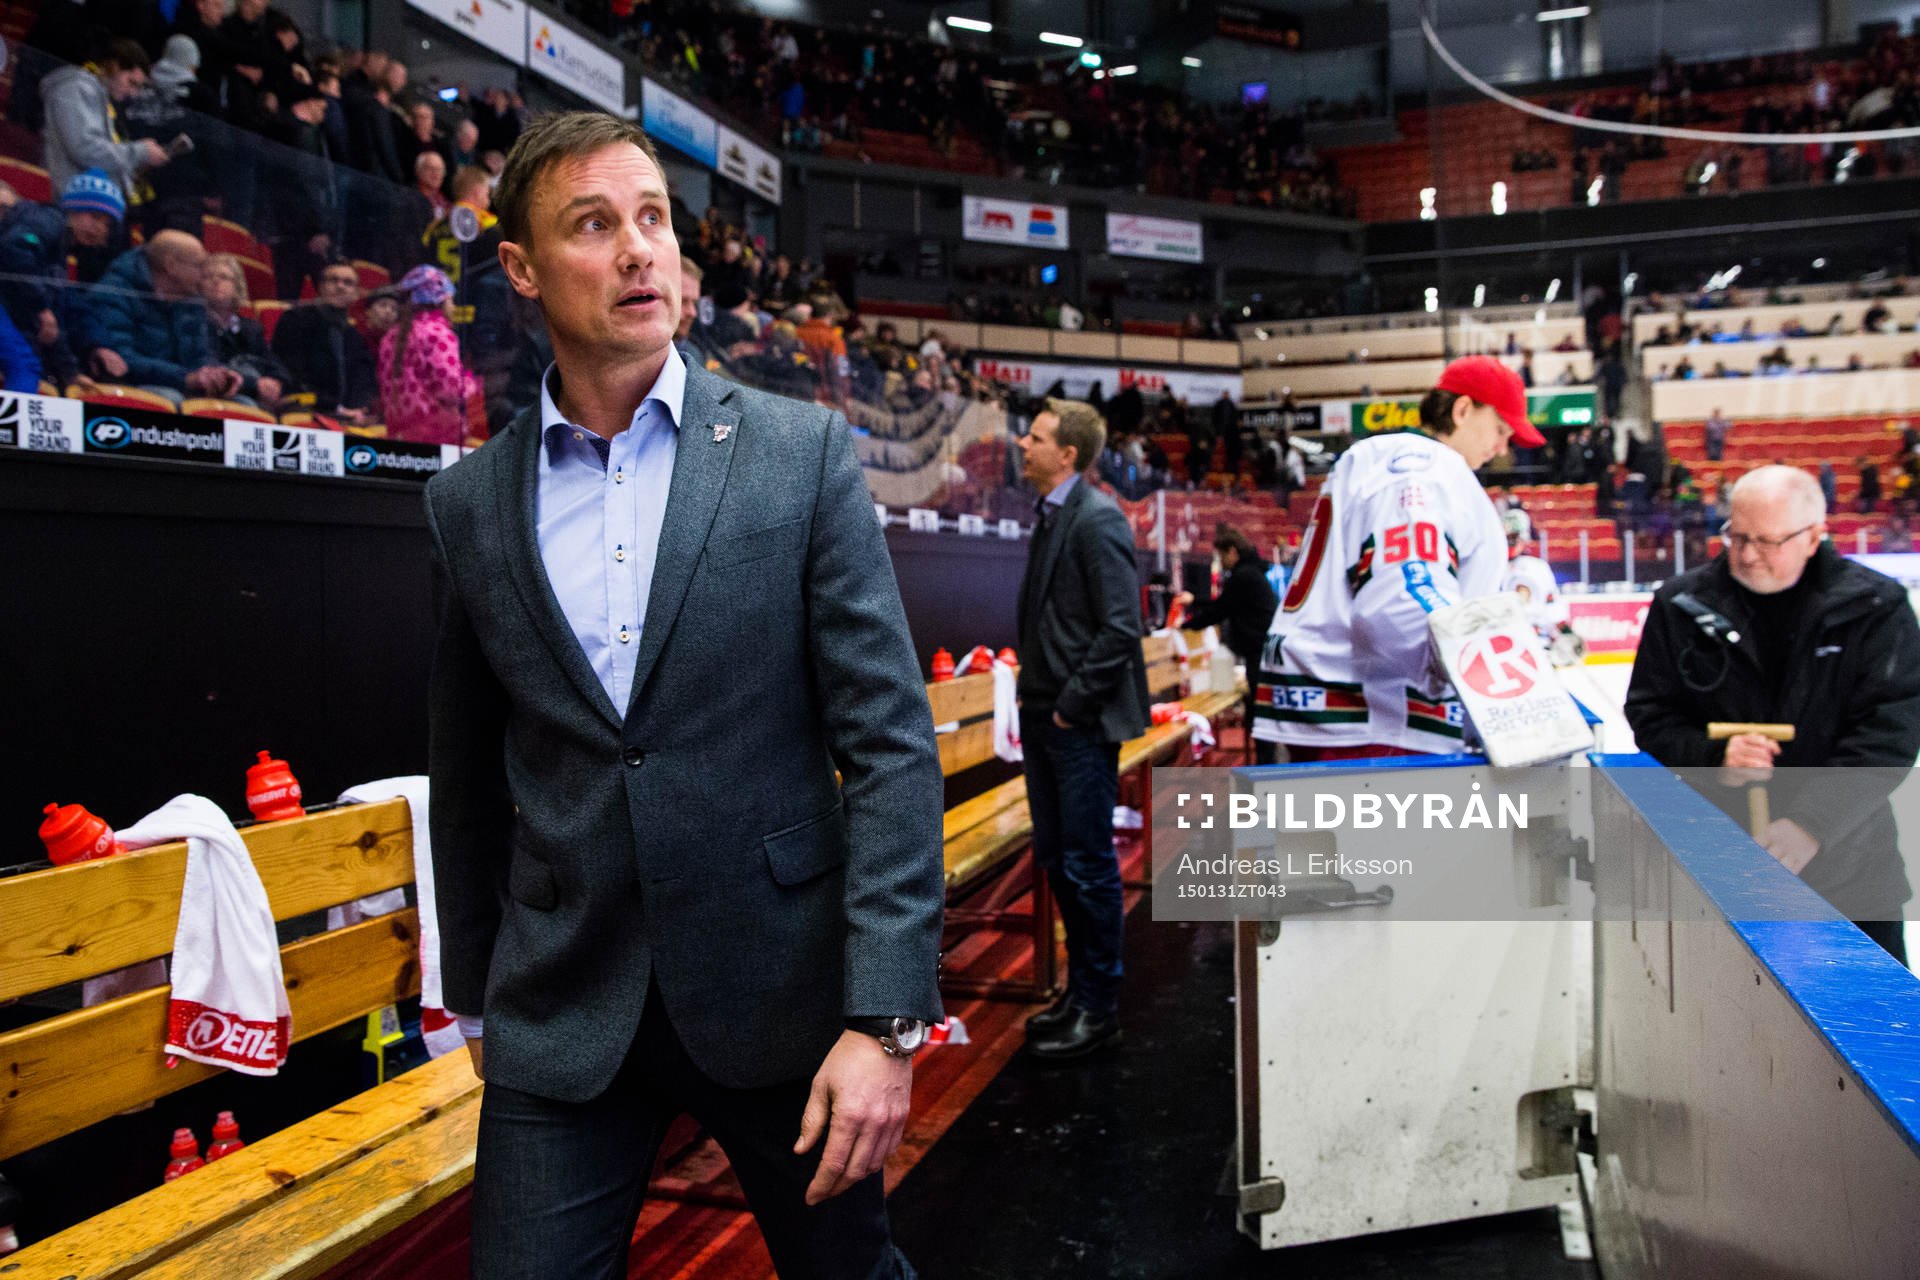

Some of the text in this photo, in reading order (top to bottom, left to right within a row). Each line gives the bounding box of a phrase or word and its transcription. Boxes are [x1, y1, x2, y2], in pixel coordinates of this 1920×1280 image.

[28, 400, 43, 416] BE
[29, 417, 63, 434] YOUR
[28, 434, 71, 452] BRAND
[242, 440, 265, 454] YOUR
[1384, 521, 1439, 564] 50
